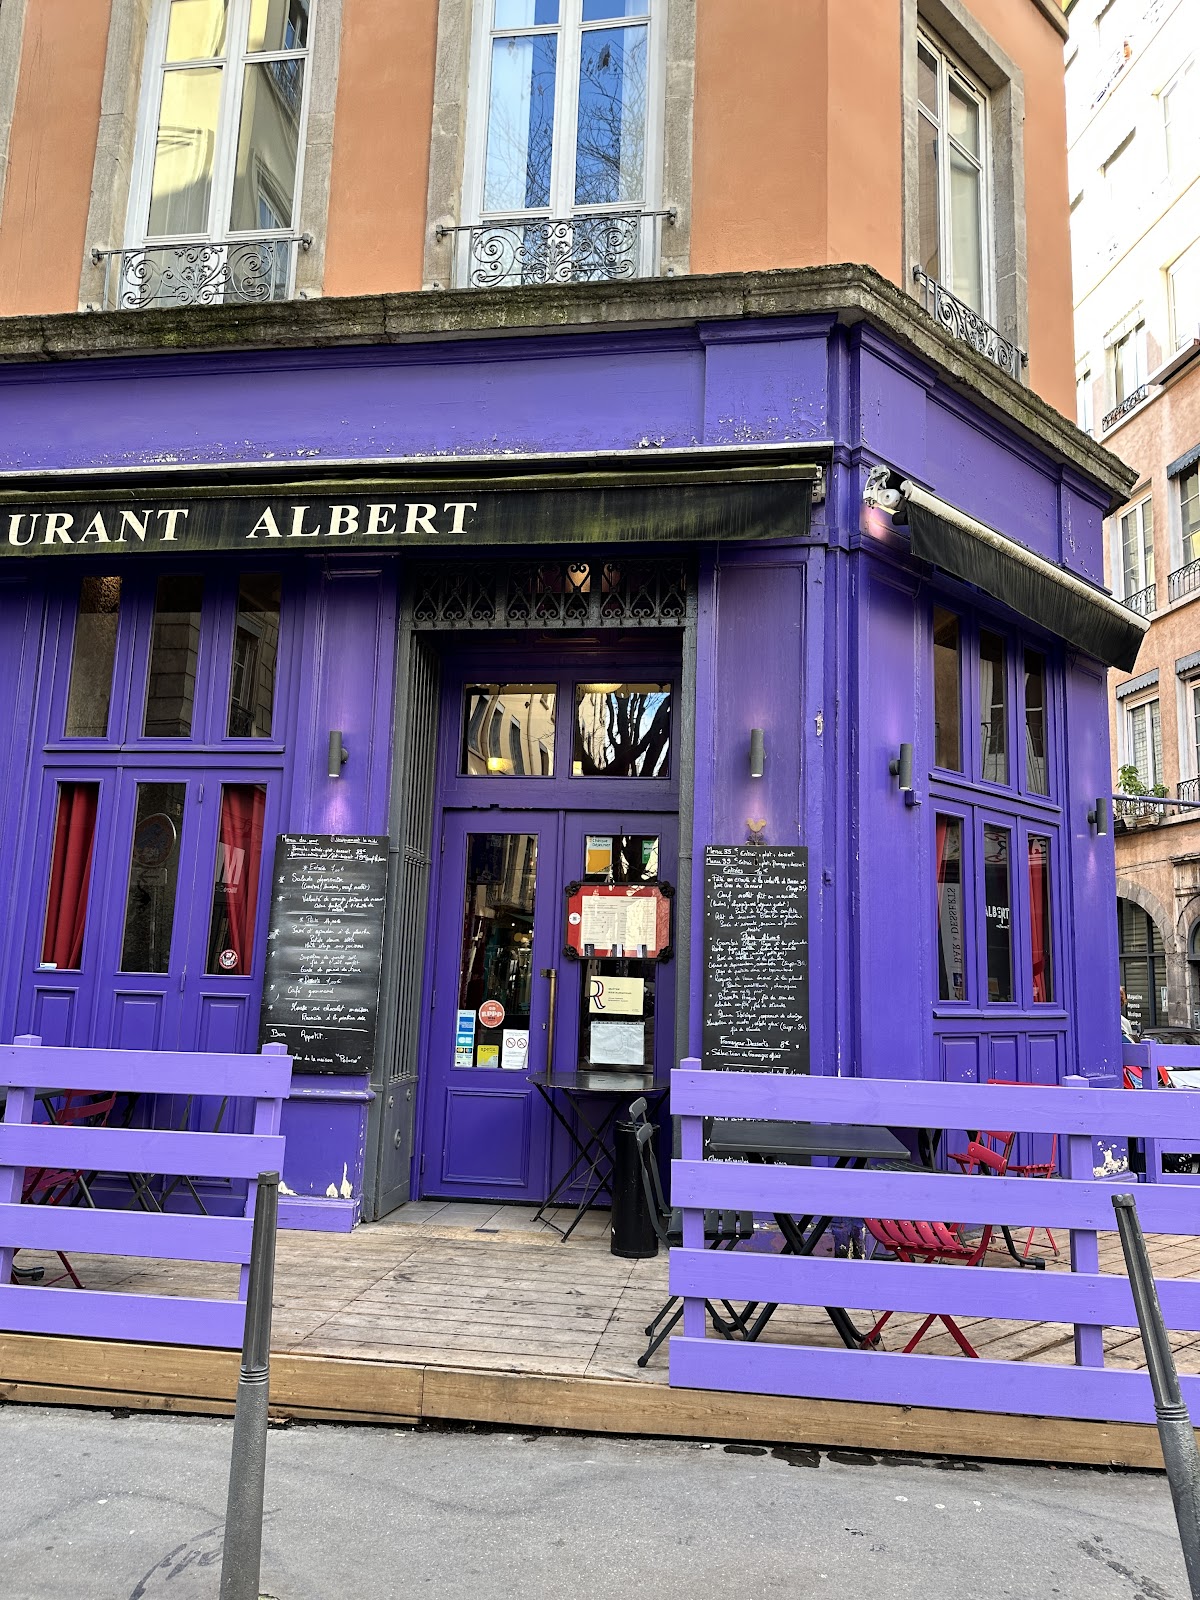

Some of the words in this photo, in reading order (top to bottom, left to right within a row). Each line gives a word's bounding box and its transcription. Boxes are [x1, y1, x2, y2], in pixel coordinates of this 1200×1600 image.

[7, 508, 189, 547] URANT
[246, 502, 479, 540] ALBERT
[270, 1028, 286, 1038] Bon
